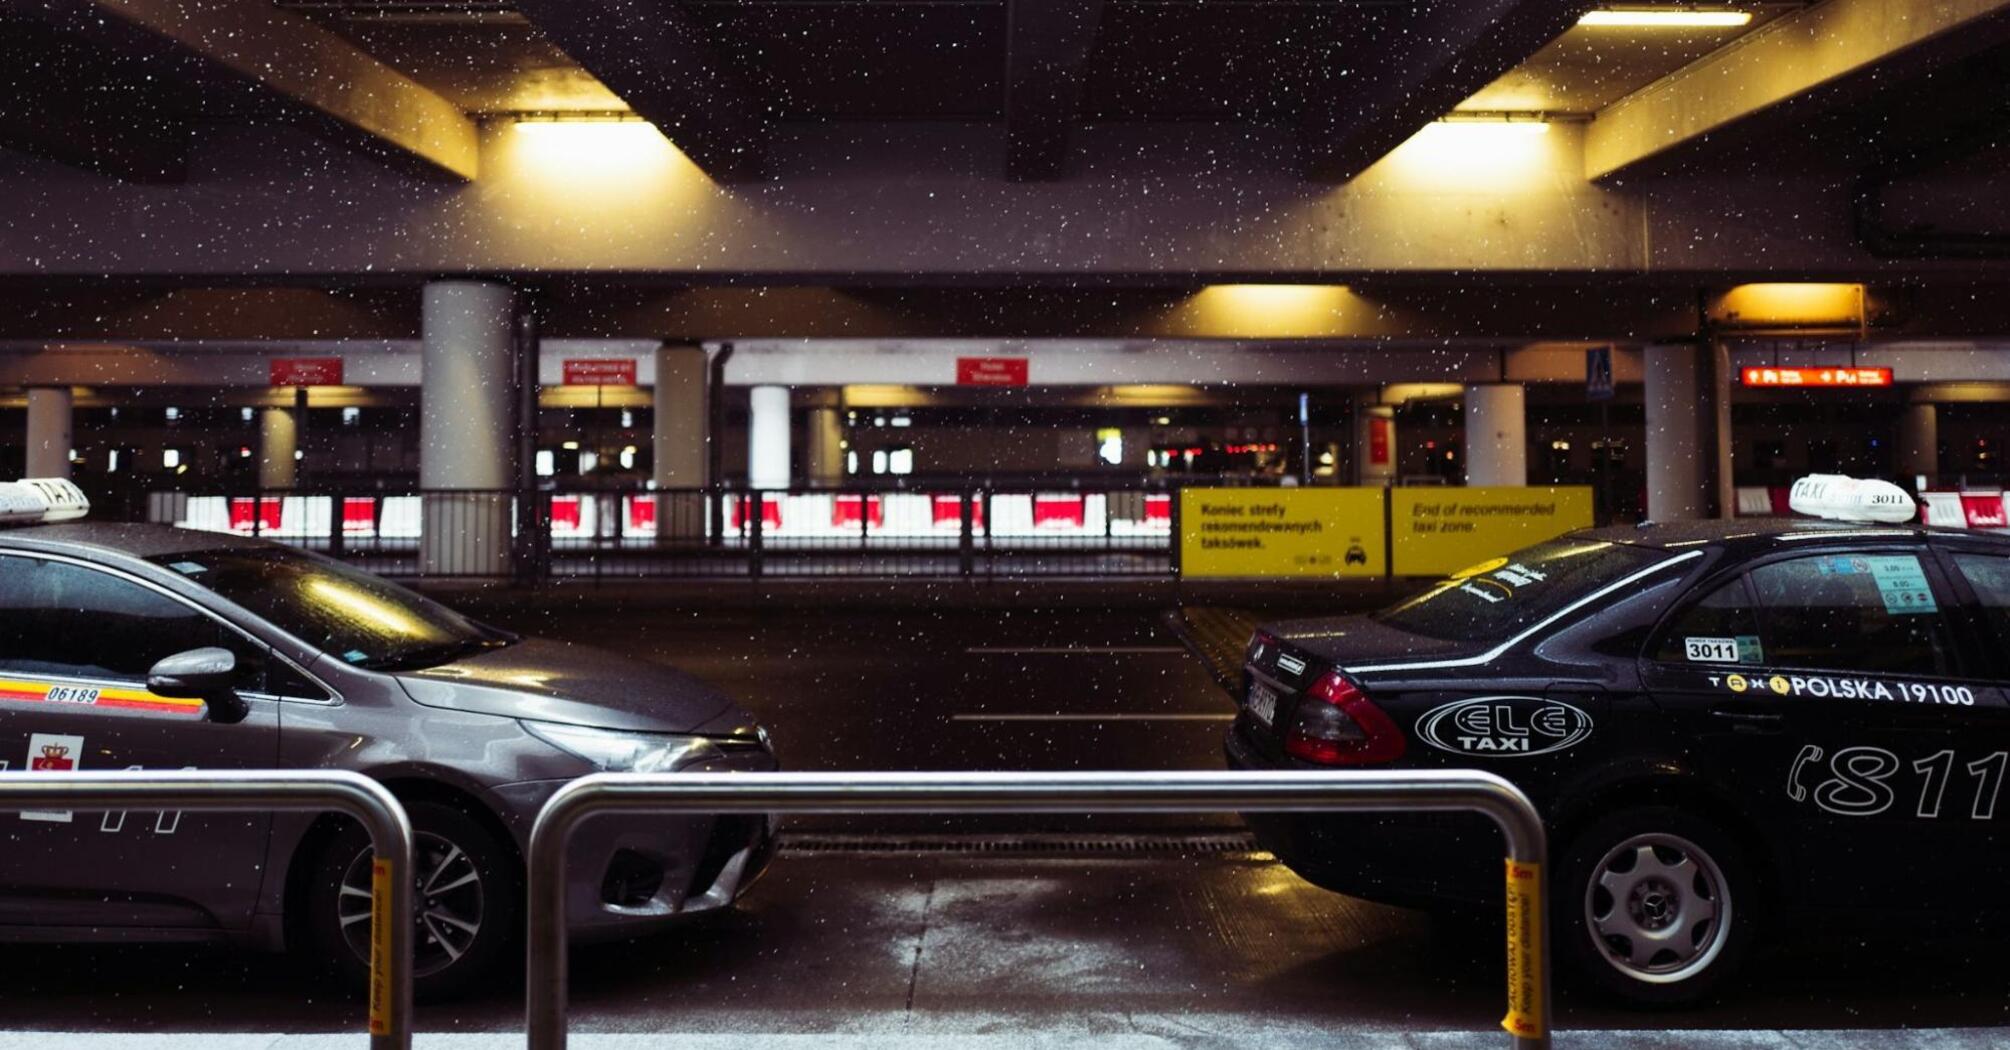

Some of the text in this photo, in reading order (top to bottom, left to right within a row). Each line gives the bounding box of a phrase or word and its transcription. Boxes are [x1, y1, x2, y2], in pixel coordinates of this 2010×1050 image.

[1794, 481, 1828, 500] TAXI
[1871, 494, 1905, 505] 3011
[1201, 502, 1287, 519] Koniec strefy
[1412, 502, 1556, 517] End of recommended
[1201, 519, 1324, 536] rekomendowanych
[1412, 520, 1477, 534] taxi zone.
[1201, 536, 1266, 550] taksówek.
[1689, 643, 1734, 659] 3011
[48, 686, 100, 704] 06189
[1792, 677, 1894, 701] POLSKA
[1896, 682, 1975, 706] 19100
[1454, 704, 1567, 737] ELE
[1457, 737, 1530, 751] TAXI
[1814, 746, 2010, 820] 811
